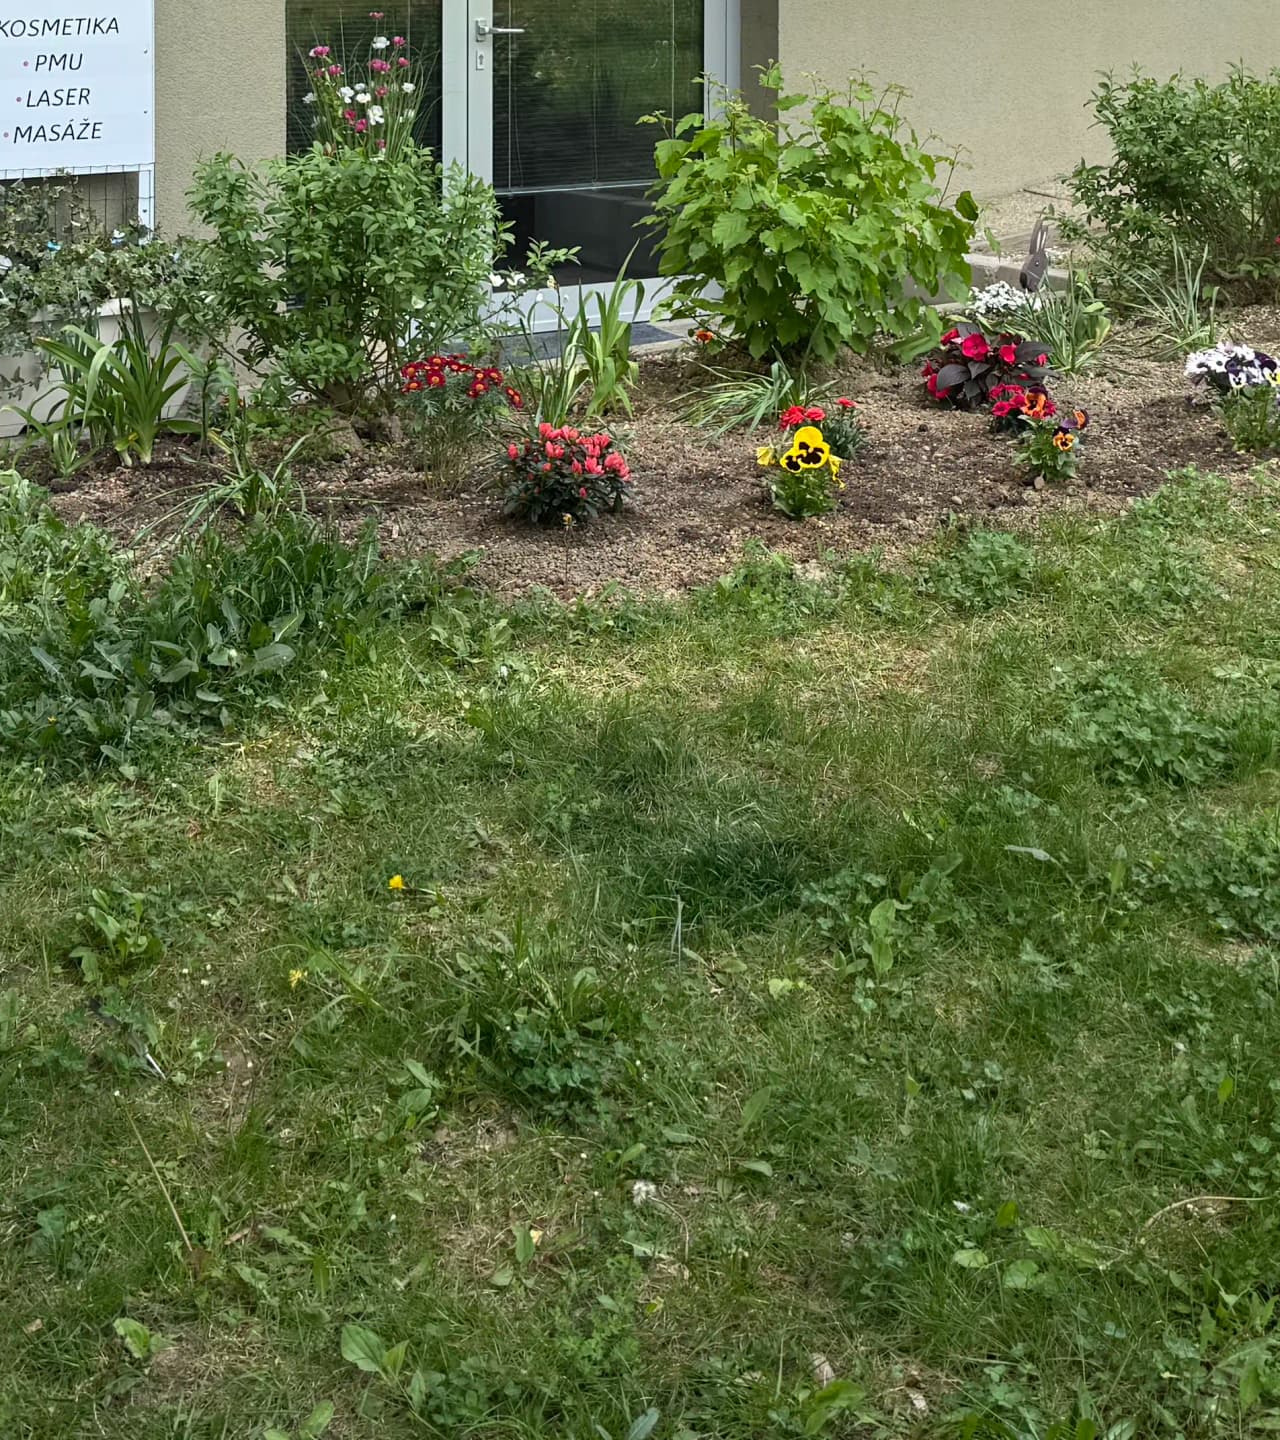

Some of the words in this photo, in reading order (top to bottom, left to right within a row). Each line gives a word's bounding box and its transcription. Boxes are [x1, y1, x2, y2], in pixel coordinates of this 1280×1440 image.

[35, 53, 83, 72] PMU
[26, 88, 90, 108] LASER
[13, 119, 103, 144] MASÁŽE
